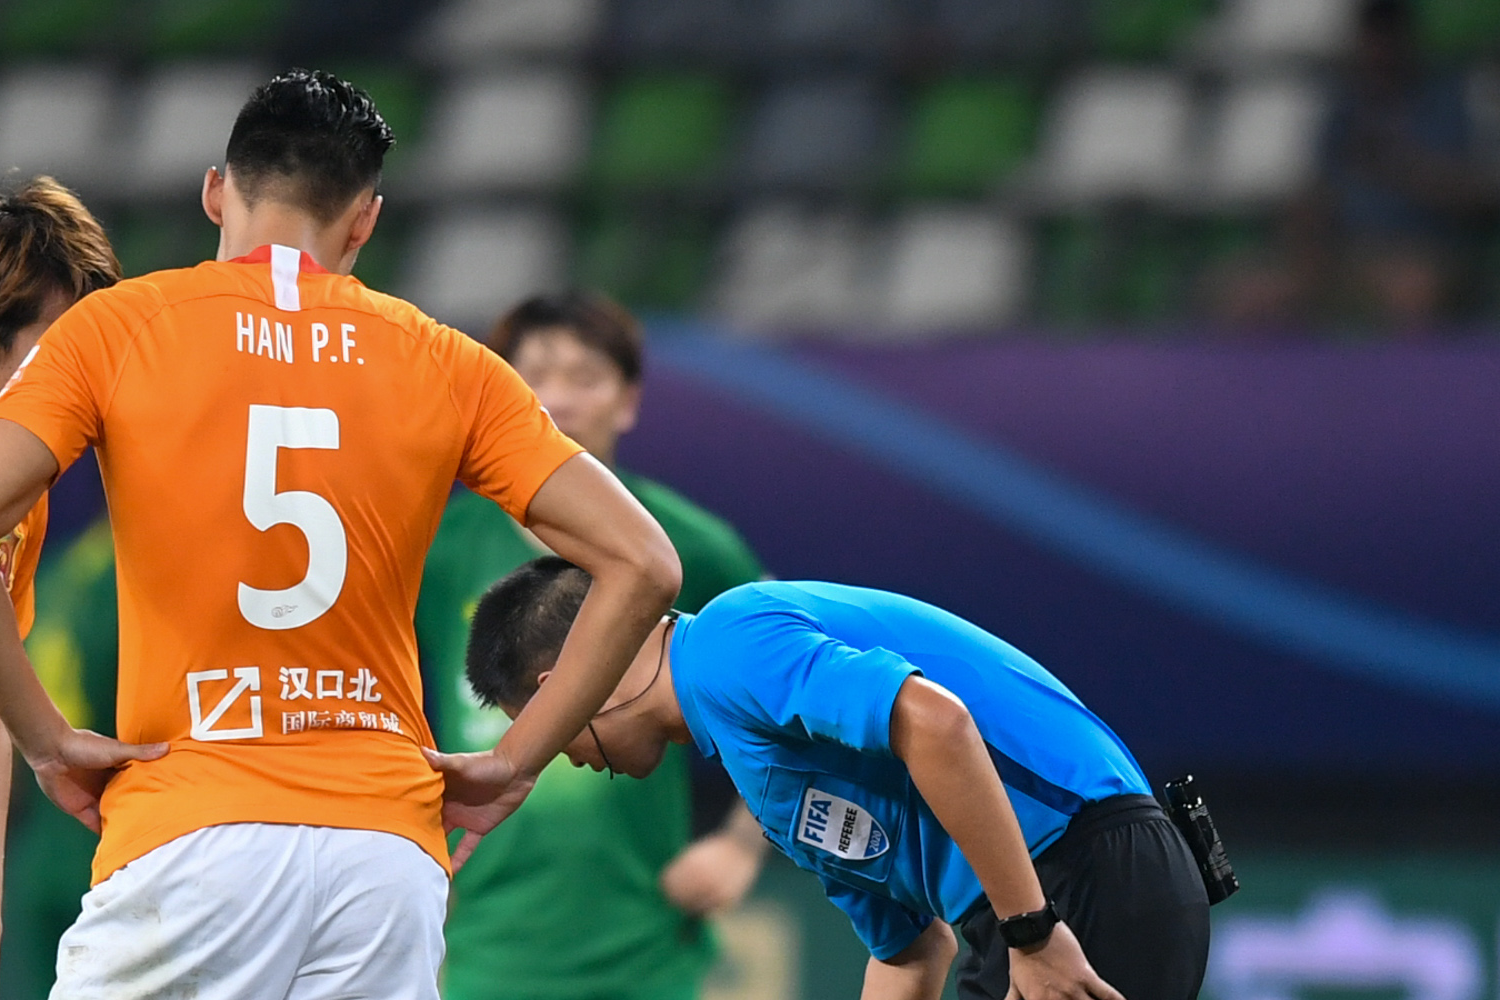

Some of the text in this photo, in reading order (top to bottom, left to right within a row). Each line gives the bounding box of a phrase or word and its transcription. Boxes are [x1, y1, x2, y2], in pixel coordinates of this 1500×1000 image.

[236, 312, 365, 365] HAN P.F.
[237, 404, 347, 630] 5
[278, 666, 382, 702] 汉口北
[803, 800, 832, 844] FIFA
[838, 807, 858, 853] REFEREE
[869, 830, 882, 853] 2020
